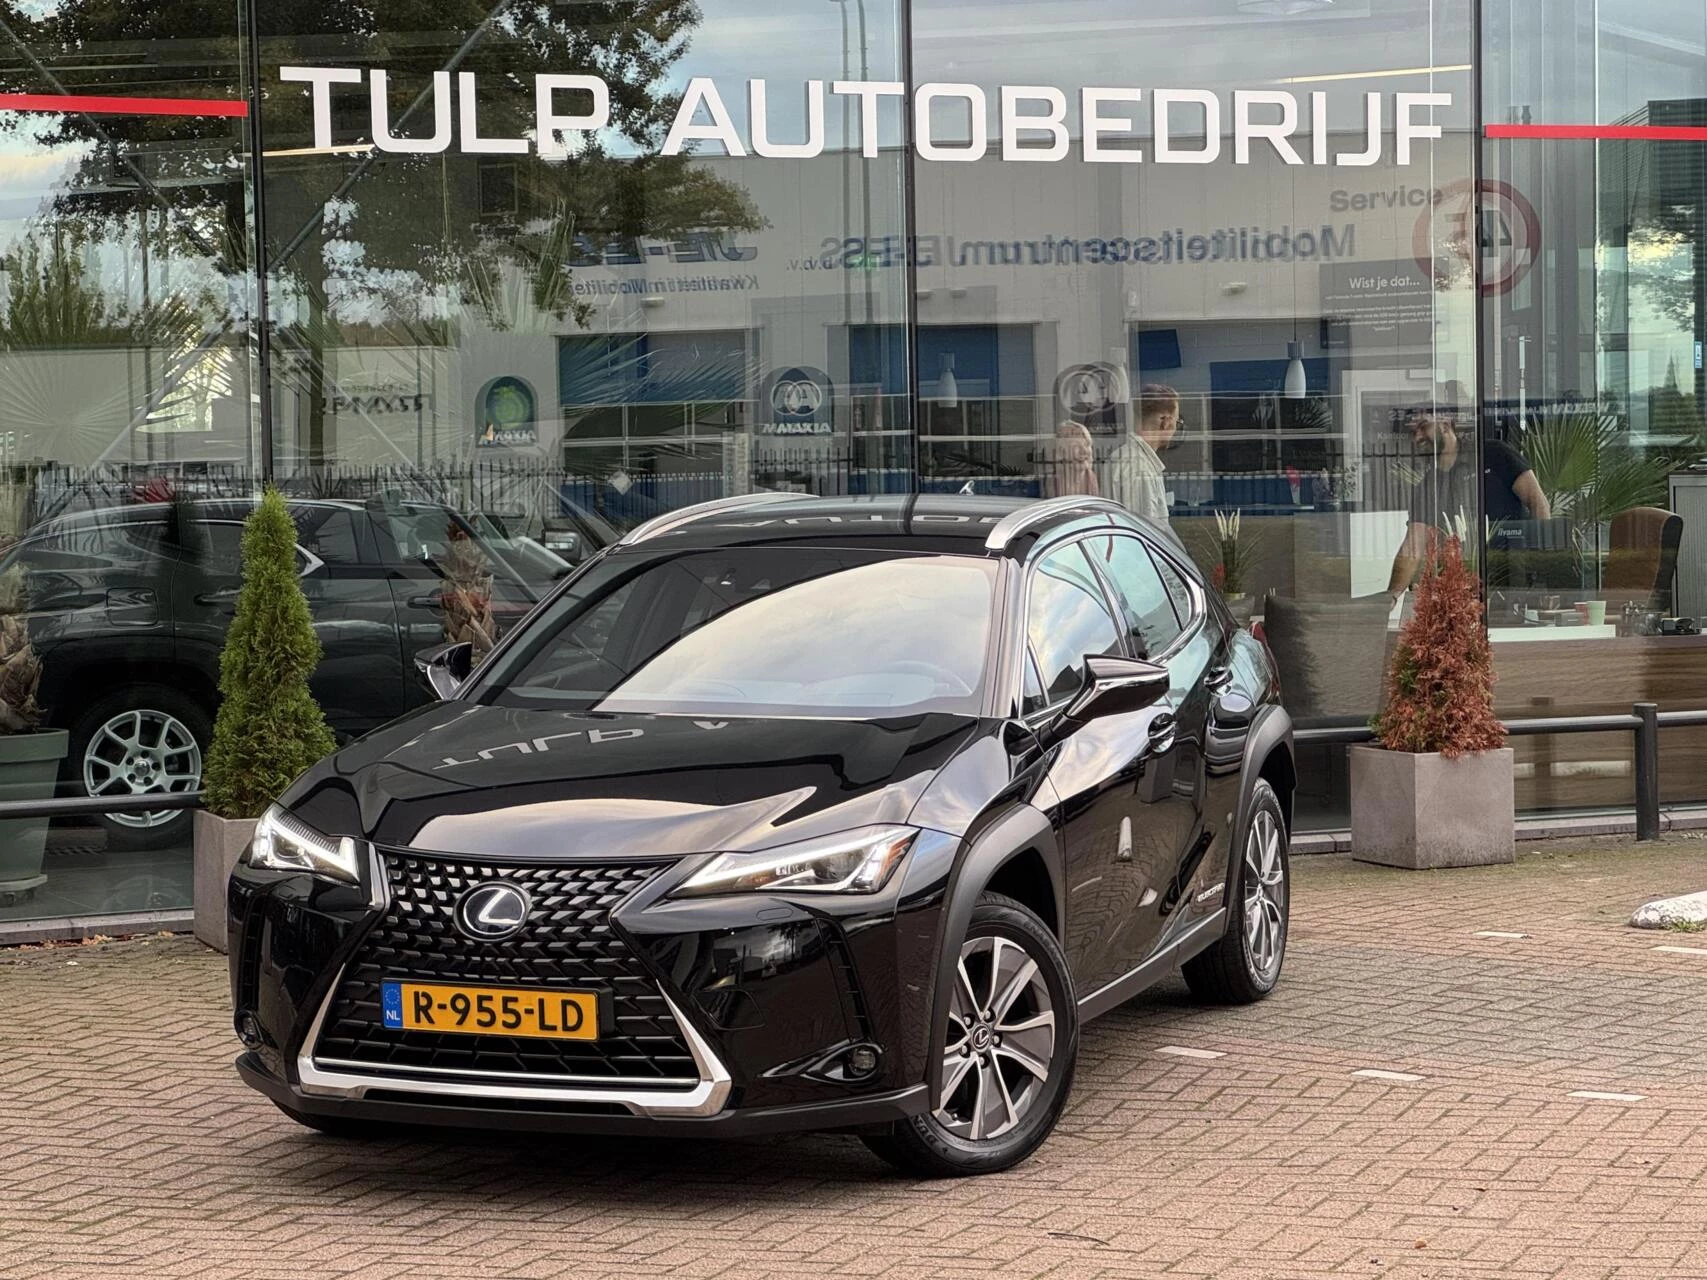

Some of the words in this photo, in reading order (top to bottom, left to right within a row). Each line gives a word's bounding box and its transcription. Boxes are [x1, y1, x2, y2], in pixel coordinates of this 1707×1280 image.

[280, 66, 609, 161] TULP
[660, 77, 1452, 166] AUTOBEDRIJF
[1329, 186, 1443, 213] Service
[1349, 277, 1375, 289] Wist
[1376, 276, 1388, 291] je
[386, 1009, 401, 1021] NL
[413, 990, 584, 1032] R-955-LD
